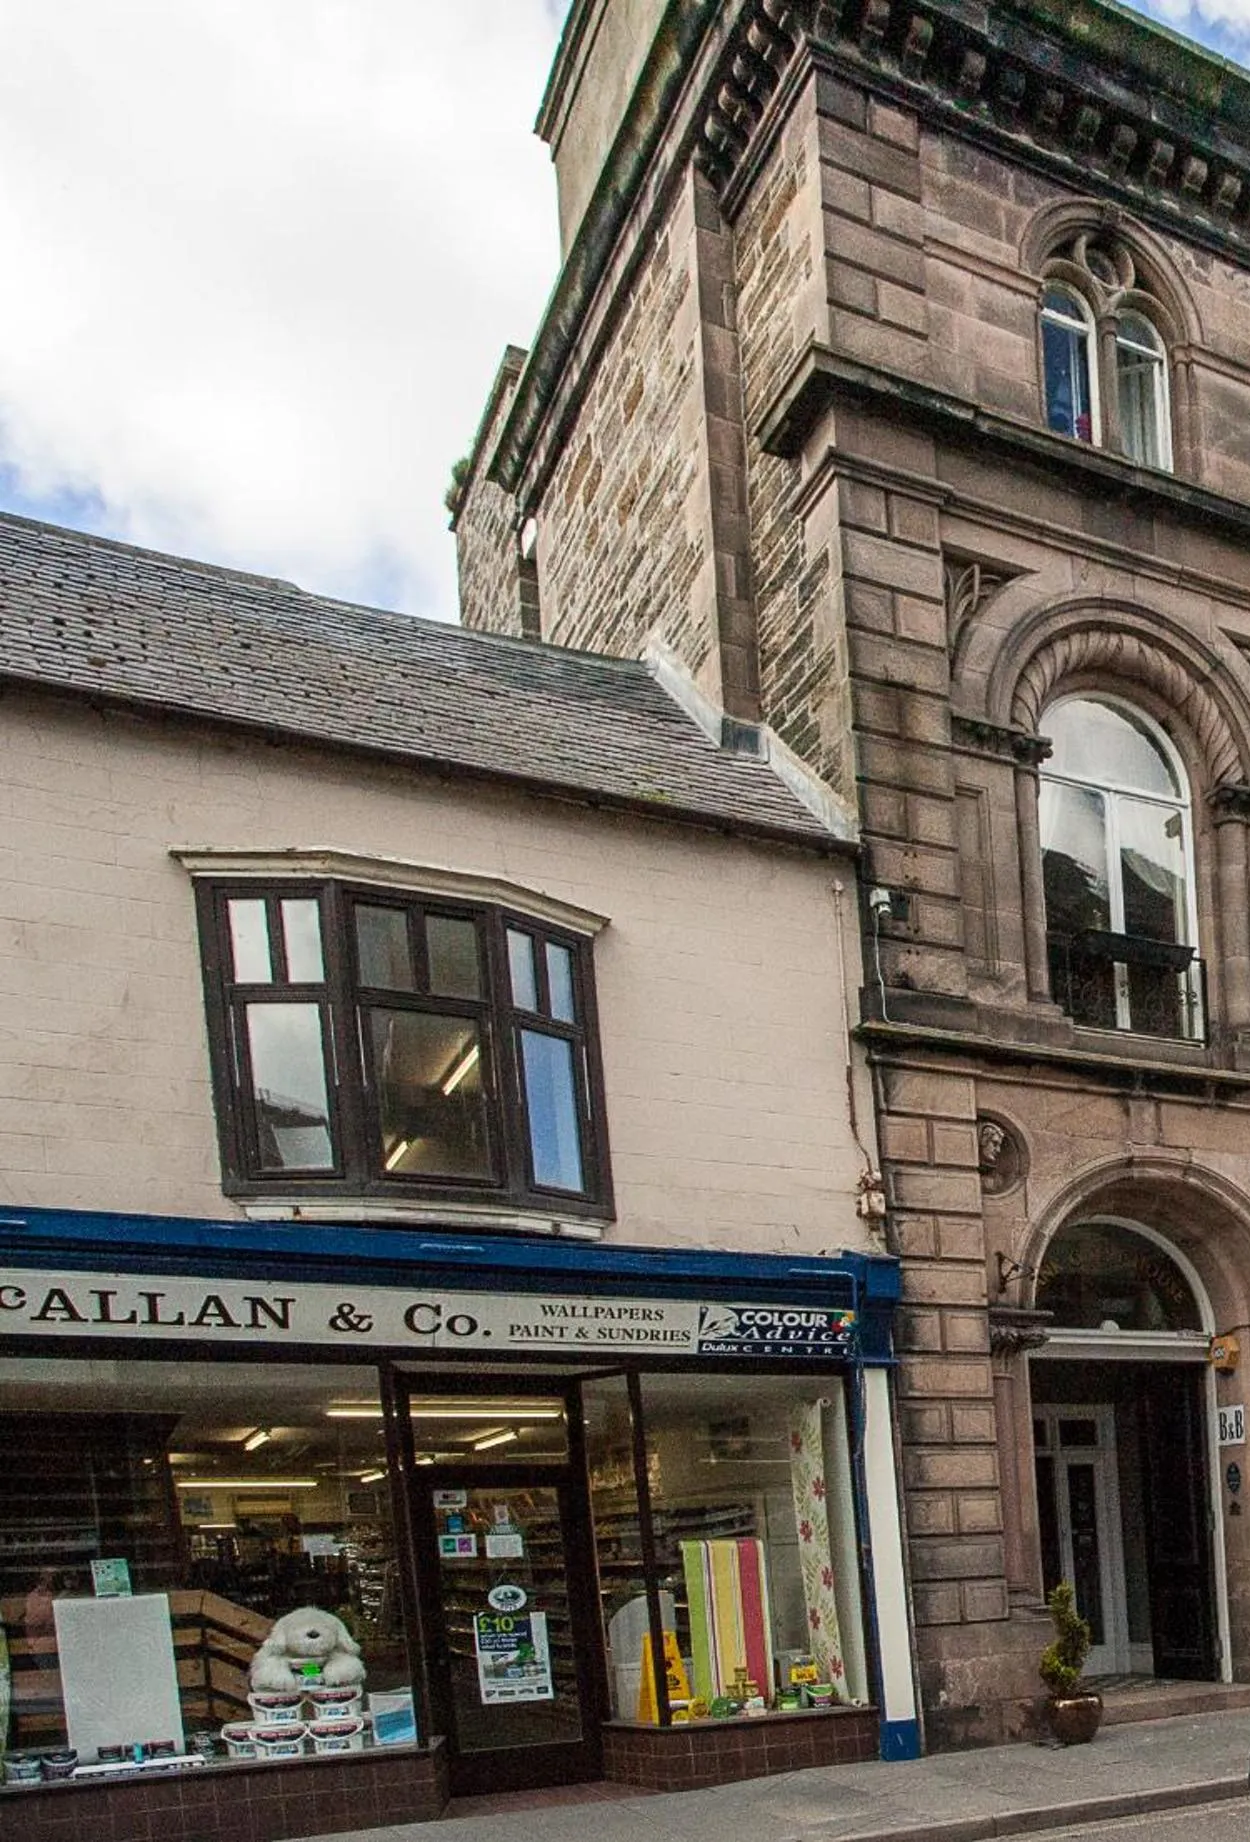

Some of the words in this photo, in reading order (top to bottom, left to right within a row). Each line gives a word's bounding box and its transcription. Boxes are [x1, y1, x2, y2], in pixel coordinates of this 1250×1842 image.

[328, 1302, 374, 1332] &
[540, 1304, 665, 1321] WALLPAPERS
[740, 1311, 828, 1328] COLOUR
[508, 1324, 569, 1338] PAINT
[574, 1326, 589, 1339] &
[597, 1327, 692, 1342] SUNDRIES
[740, 1326, 850, 1342] Advice
[701, 1341, 738, 1352] Dulux
[1219, 1410, 1243, 1441] B&B
[479, 1615, 514, 1633] £10
